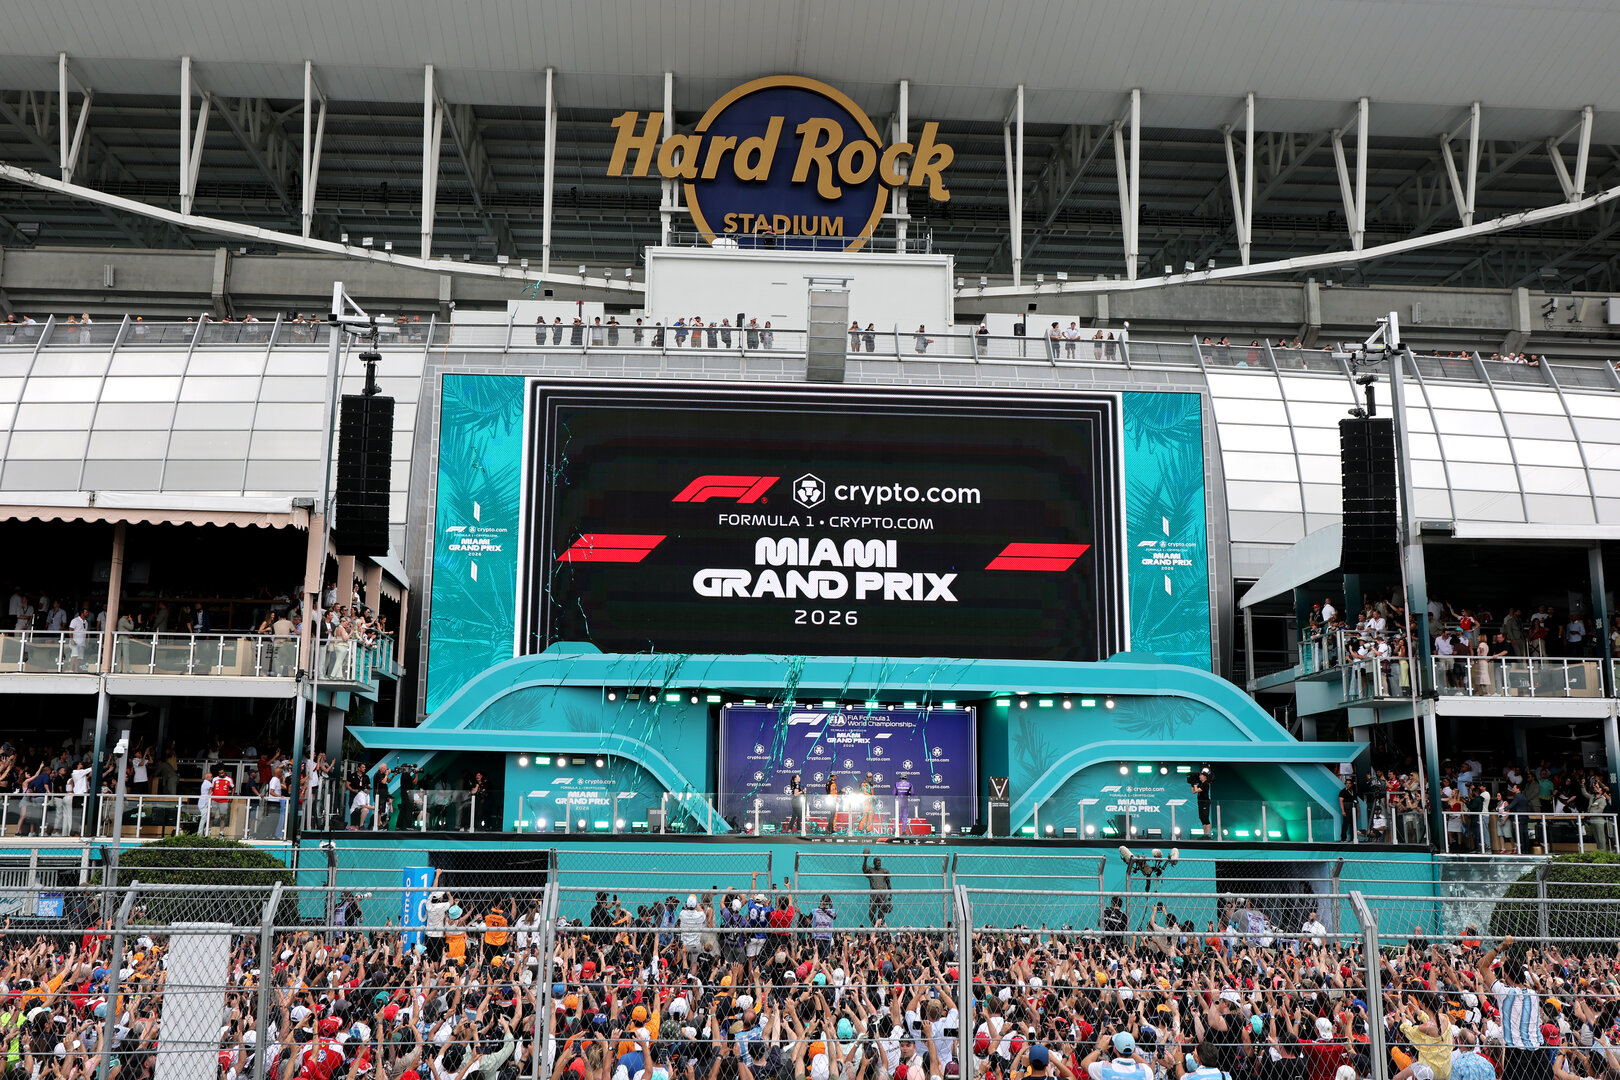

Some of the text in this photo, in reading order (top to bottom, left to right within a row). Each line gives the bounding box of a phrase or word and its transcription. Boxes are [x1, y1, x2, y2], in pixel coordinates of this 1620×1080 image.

[606, 111, 955, 202] Hard Rock
[723, 212, 844, 237] STADIUM
[834, 483, 981, 505] crypto.com
[718, 514, 934, 530] FORMULA 1 CRYPTO.COM
[754, 536, 898, 568] MIAMI
[692, 568, 959, 602] GRAND PRIX
[794, 609, 858, 626] 2026
